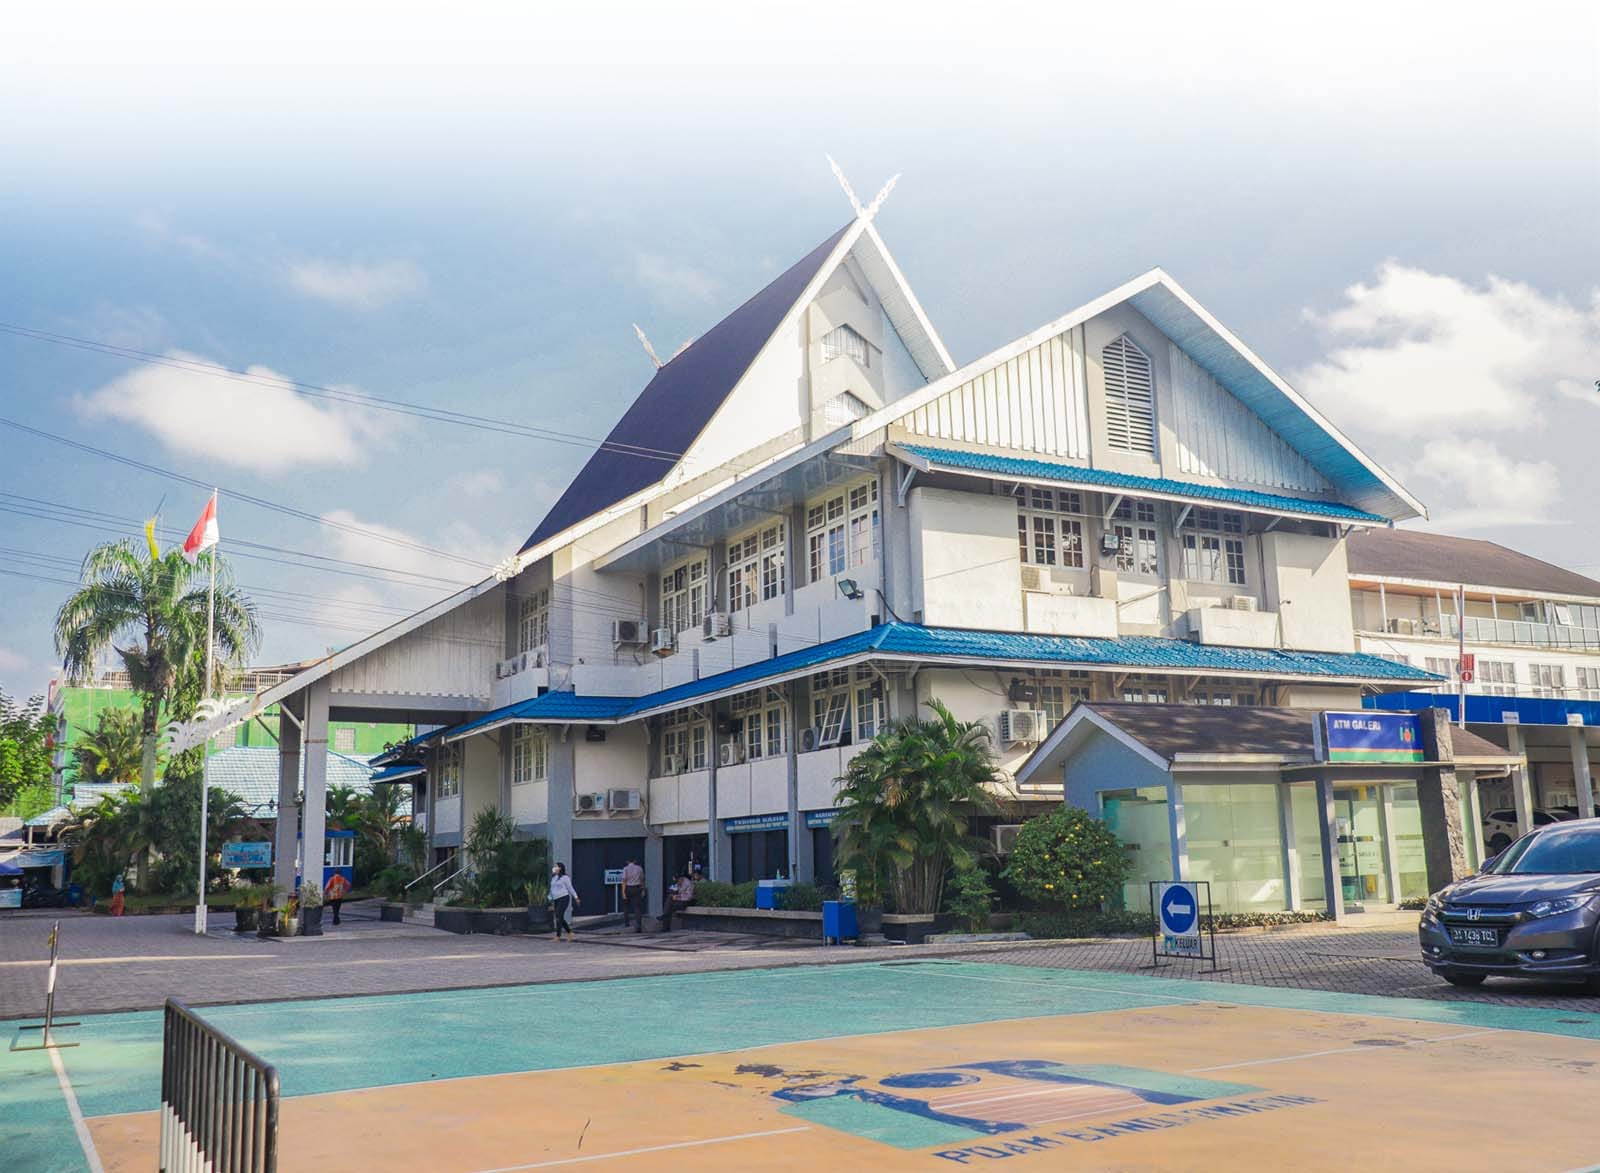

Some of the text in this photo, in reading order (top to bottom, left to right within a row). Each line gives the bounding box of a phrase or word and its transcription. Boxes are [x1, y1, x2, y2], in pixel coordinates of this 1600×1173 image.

[1333, 719, 1381, 731] ATM GALERI
[931, 1136, 1067, 1164] PDAM
